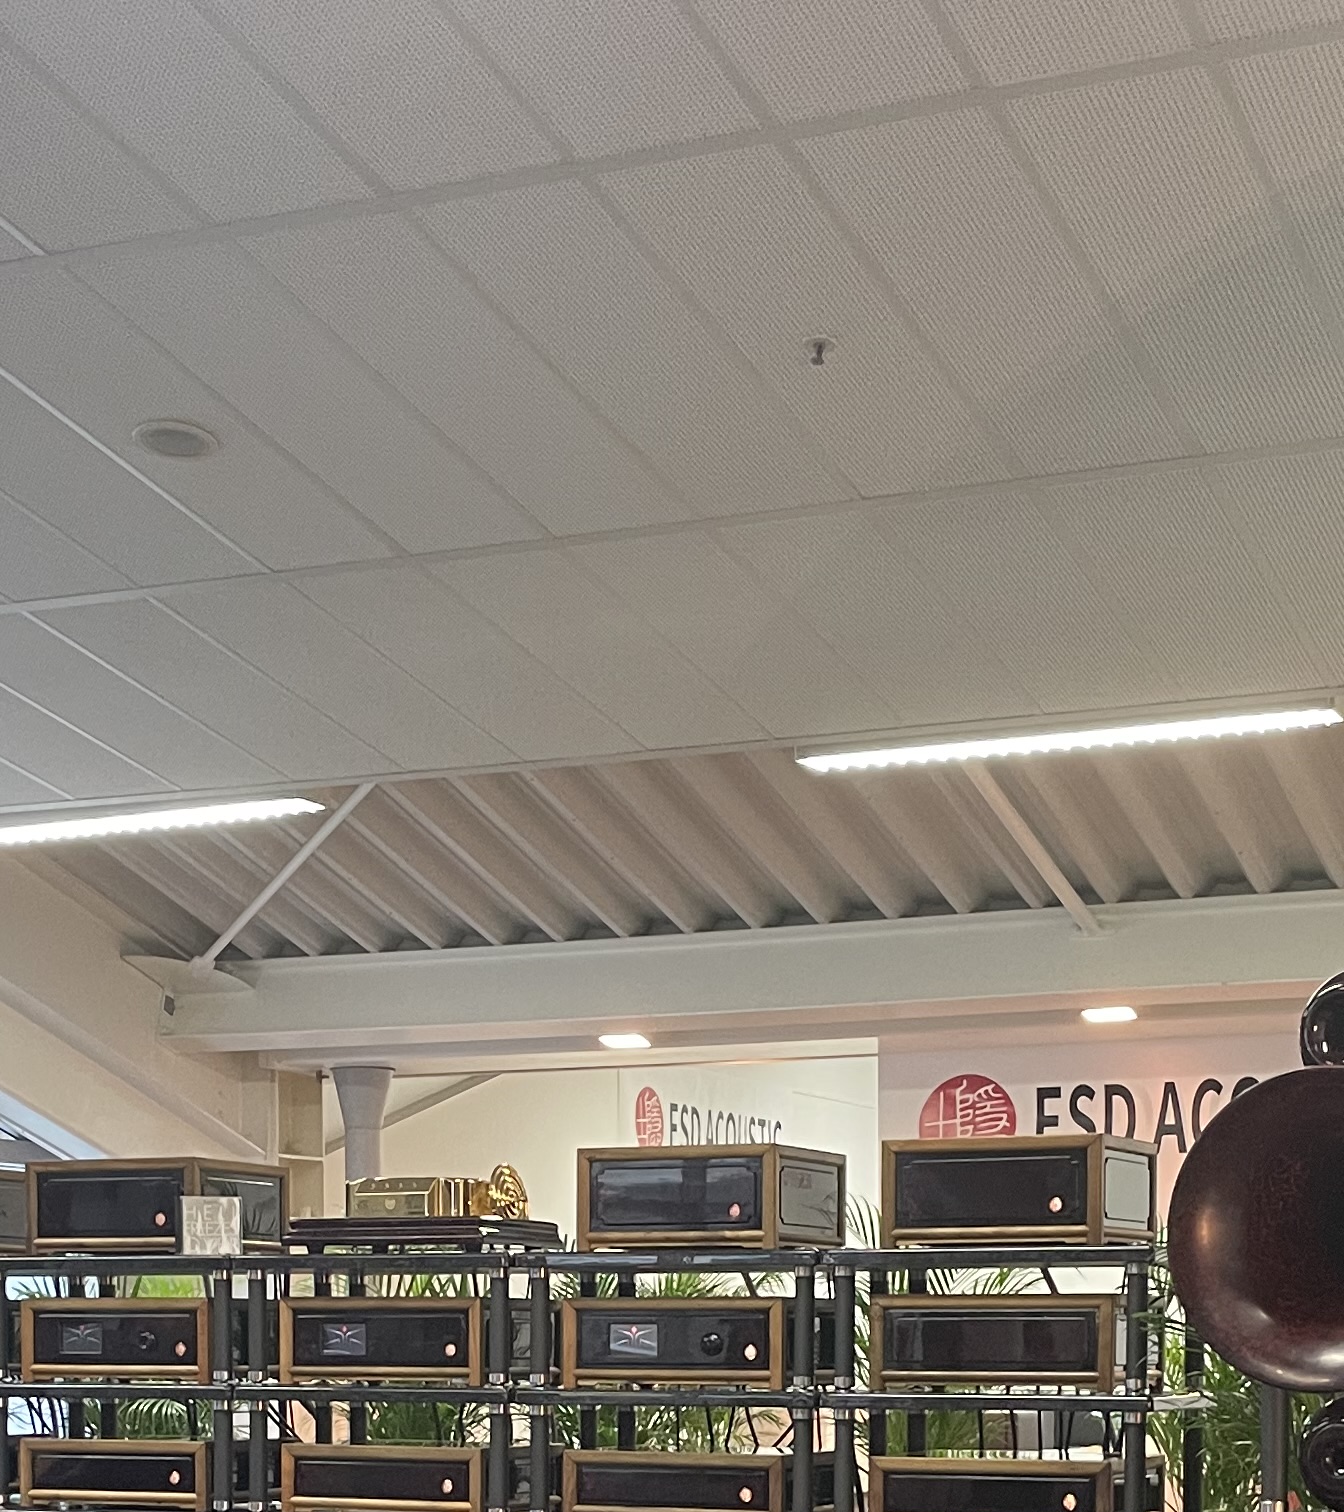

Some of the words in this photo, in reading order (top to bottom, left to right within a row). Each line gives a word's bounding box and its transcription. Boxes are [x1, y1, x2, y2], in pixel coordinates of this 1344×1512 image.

[670, 1102, 701, 1147] ESD
[706, 1109, 782, 1146] ACOUSTIC
[1036, 1083, 1136, 1138] ESD
[1154, 1076, 1260, 1153] AC
